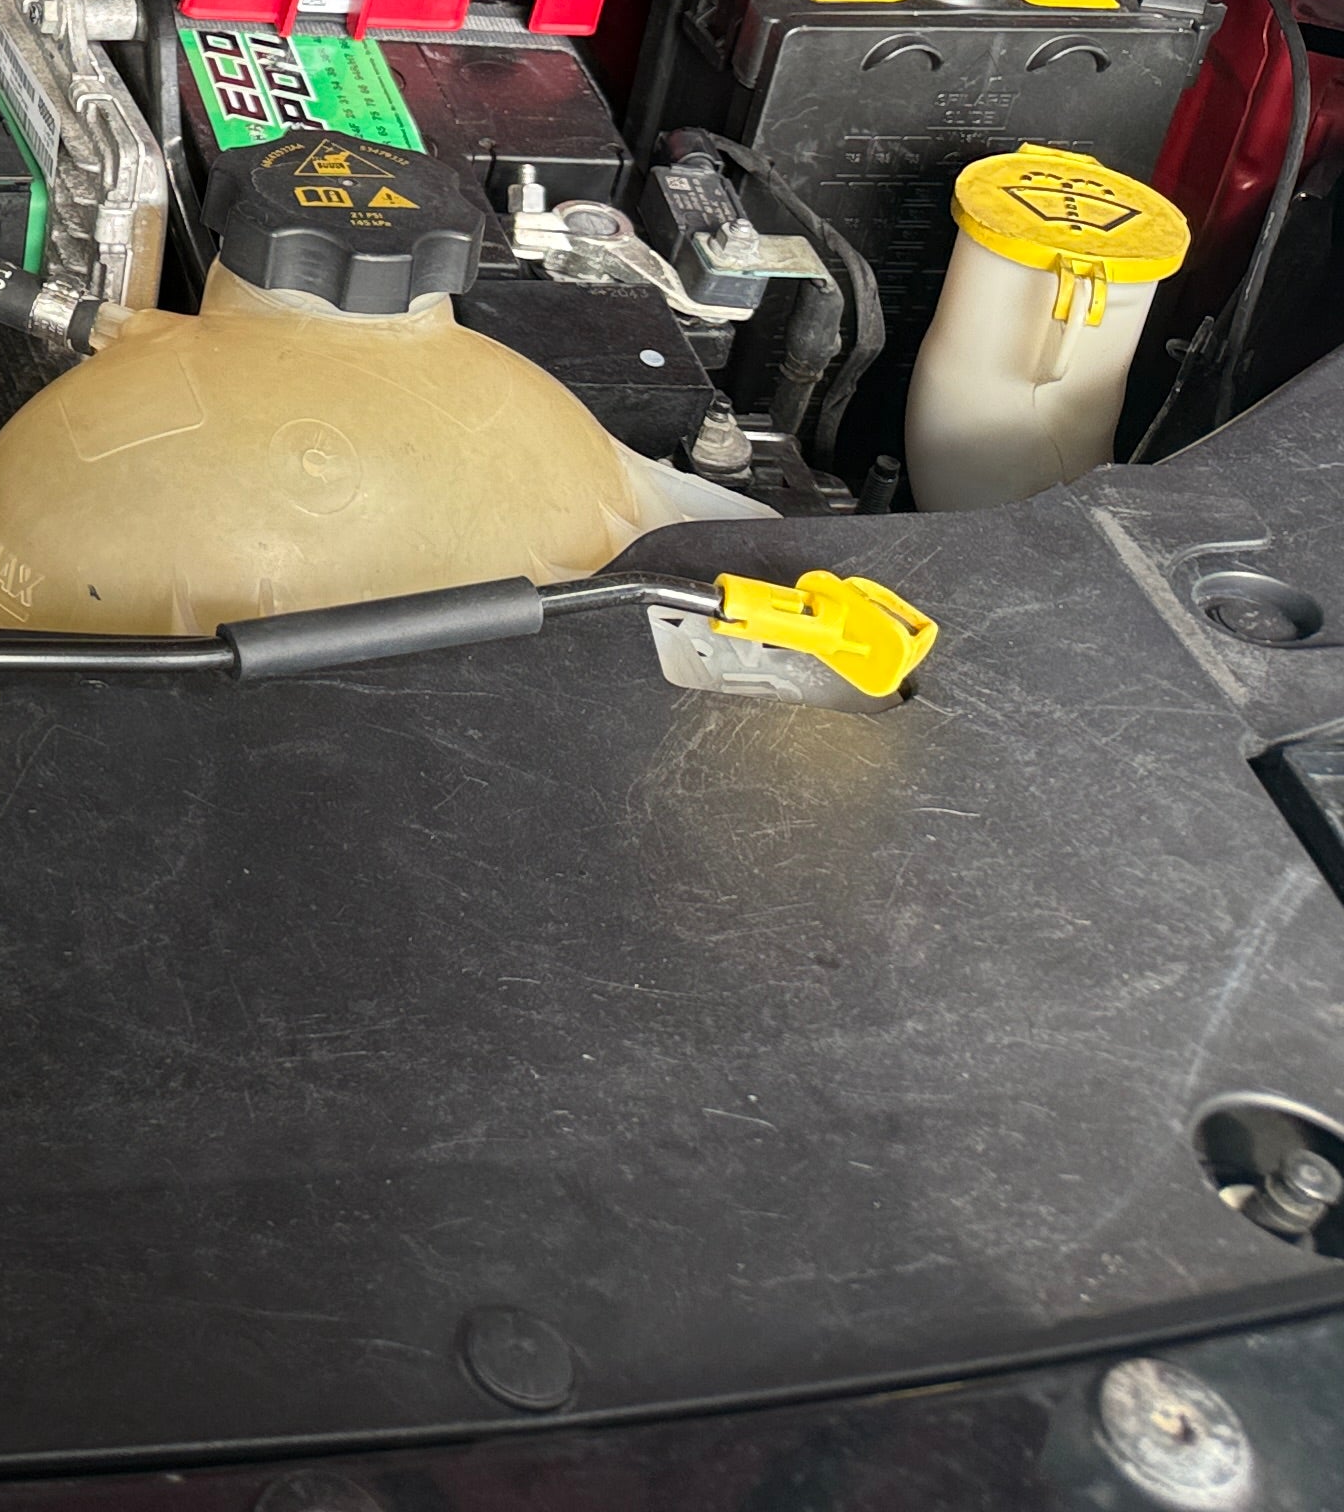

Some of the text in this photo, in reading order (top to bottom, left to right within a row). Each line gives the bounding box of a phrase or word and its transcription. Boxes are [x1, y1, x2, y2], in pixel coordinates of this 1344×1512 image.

[196, 30, 269, 124] ECO
[350, 211, 384, 219] 21 PSI
